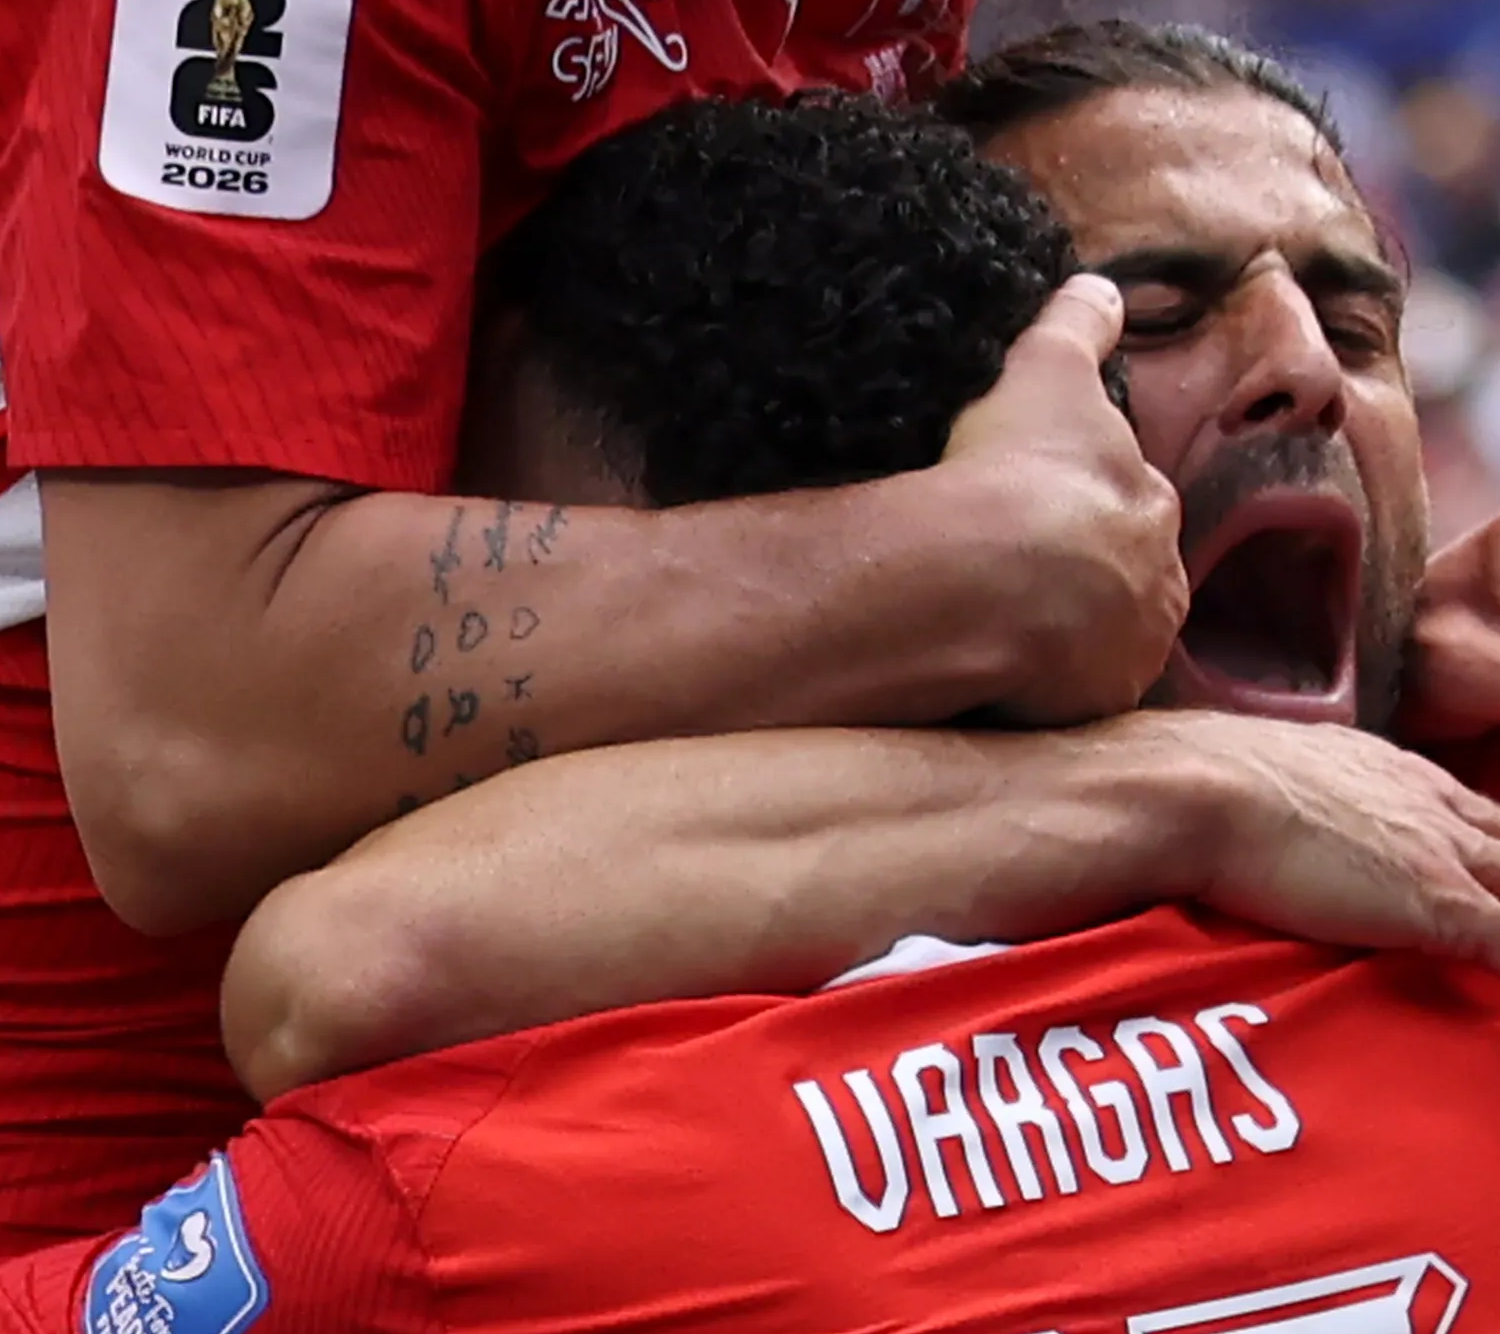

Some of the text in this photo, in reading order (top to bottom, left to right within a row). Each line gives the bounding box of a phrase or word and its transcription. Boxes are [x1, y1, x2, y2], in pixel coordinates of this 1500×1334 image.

[197, 103, 247, 129] FIFA
[165, 143, 271, 167] WORLD CUP
[161, 163, 269, 194] 2026
[793, 1002, 1300, 1233] VARGAS
